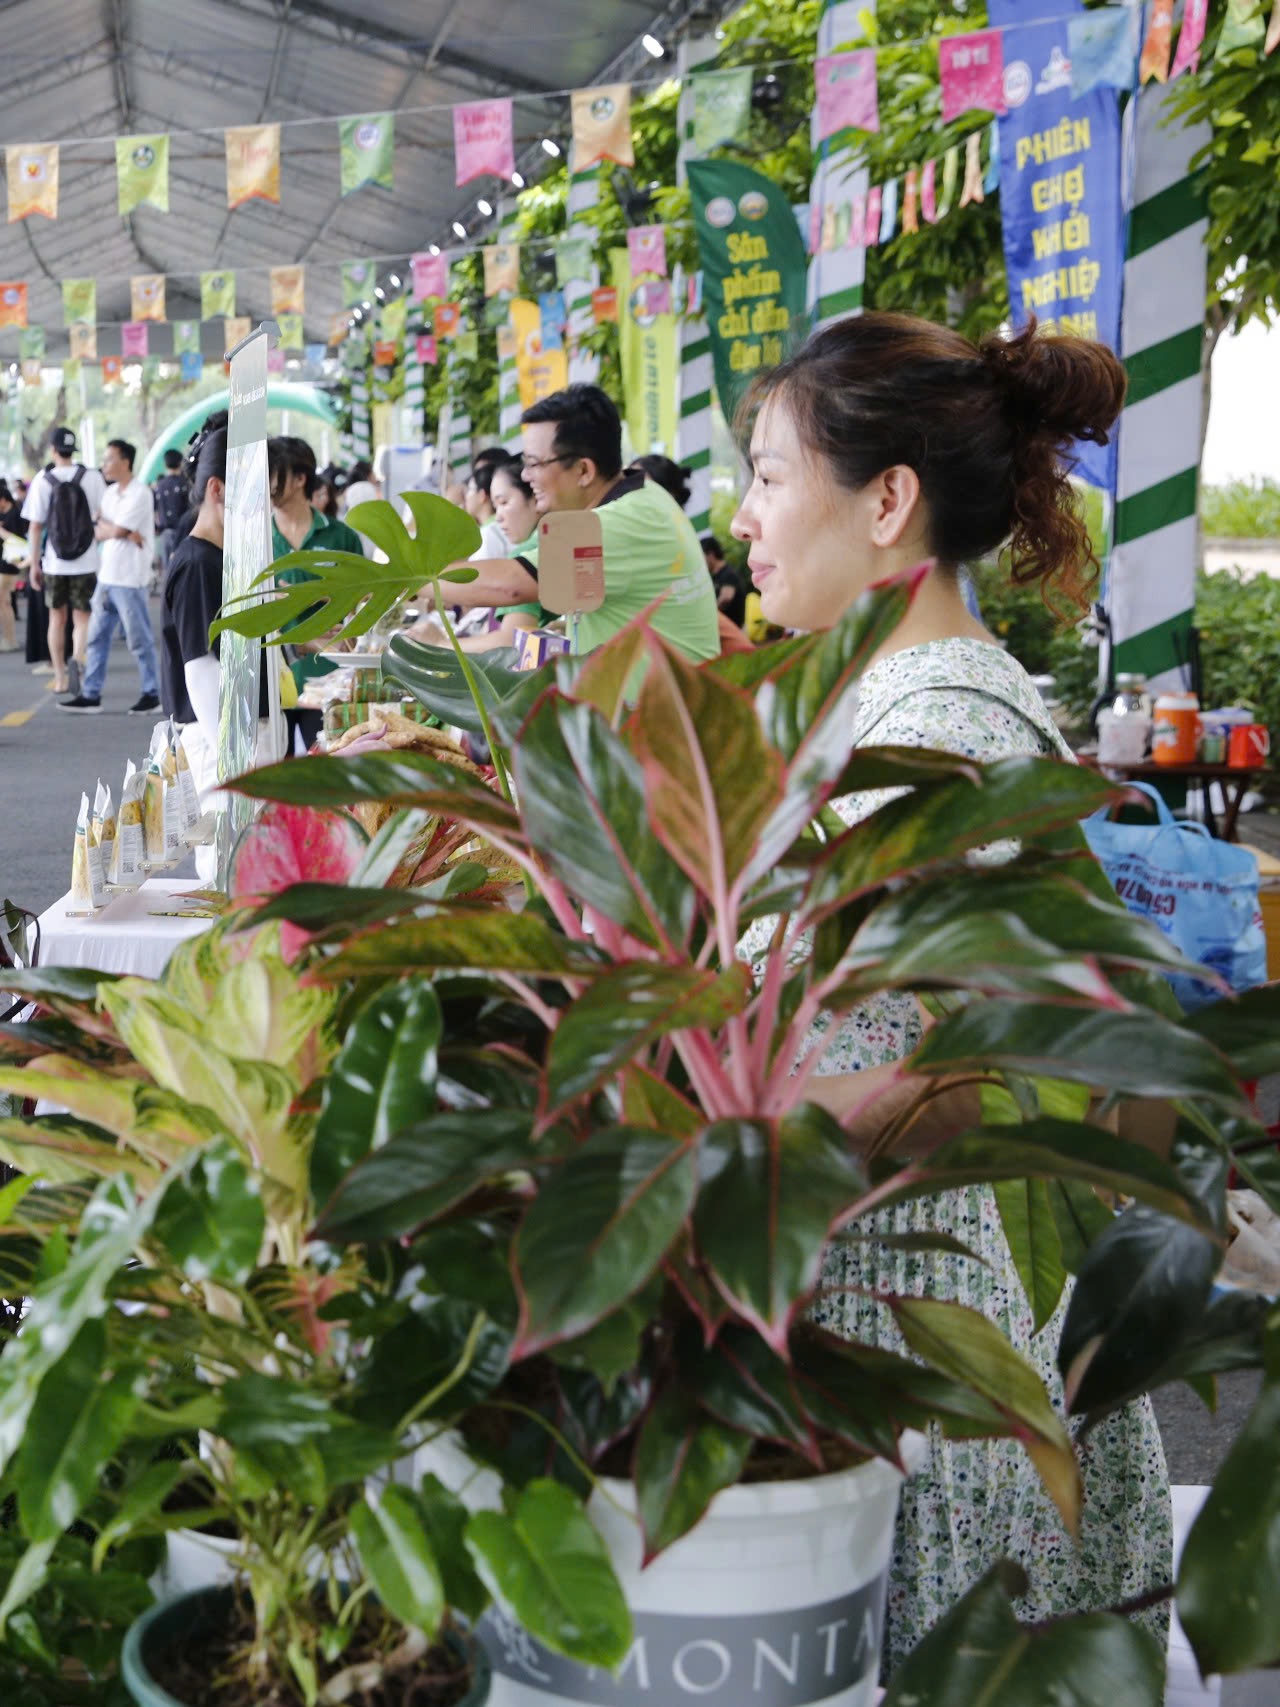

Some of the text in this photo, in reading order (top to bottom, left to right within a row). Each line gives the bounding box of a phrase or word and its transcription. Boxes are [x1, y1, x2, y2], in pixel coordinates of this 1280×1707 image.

[1016, 115, 1091, 171] PHIÊN
[1031, 163, 1085, 213] CHỢ
[1032, 208, 1091, 261] KHỞI
[1021, 256, 1100, 309] NGHIỆP
